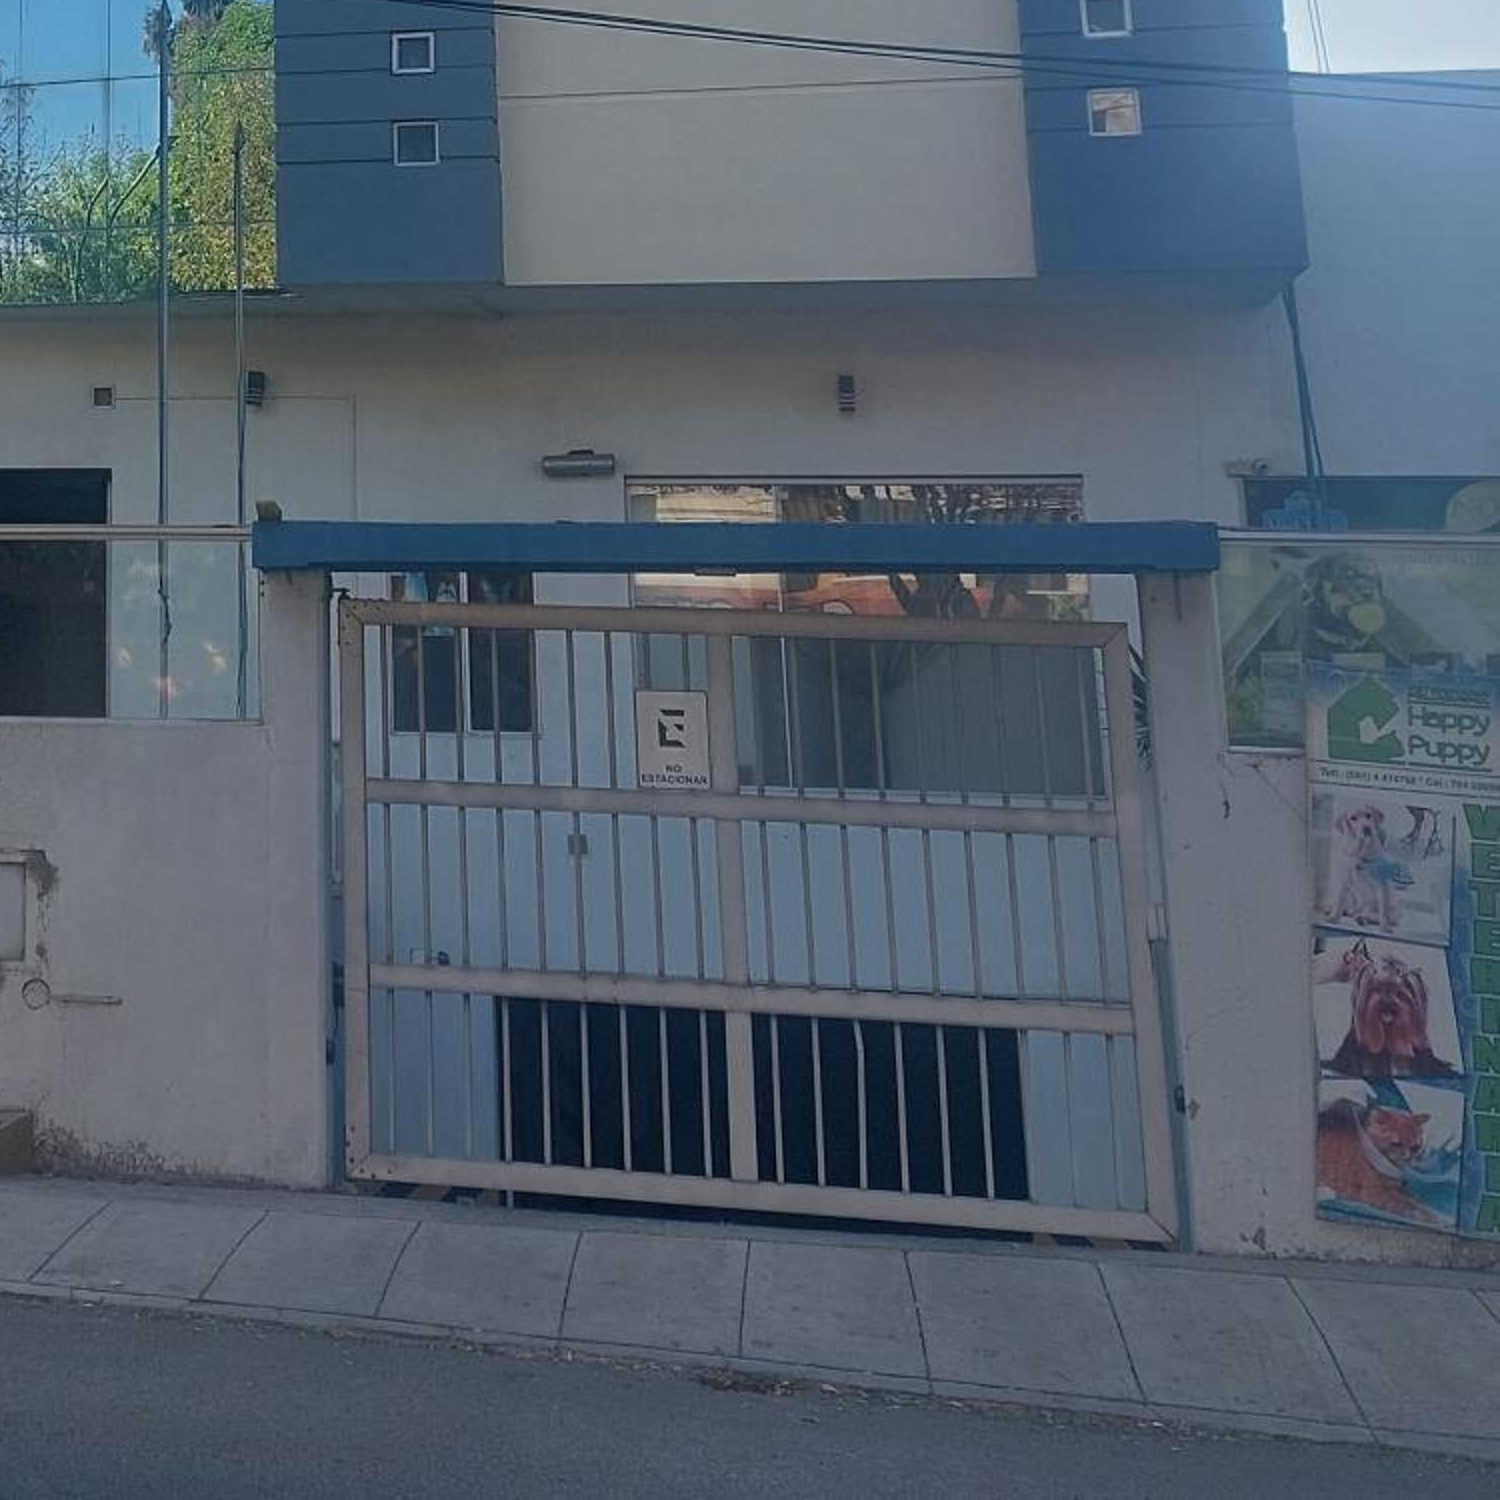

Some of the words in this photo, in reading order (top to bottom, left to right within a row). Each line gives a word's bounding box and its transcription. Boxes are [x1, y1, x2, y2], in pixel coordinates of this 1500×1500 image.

[1407, 706, 1491, 736] Happy
[1408, 735, 1491, 766] Puppy
[665, 764, 683, 773] NO
[641, 774, 709, 785] ESTACIONAR
